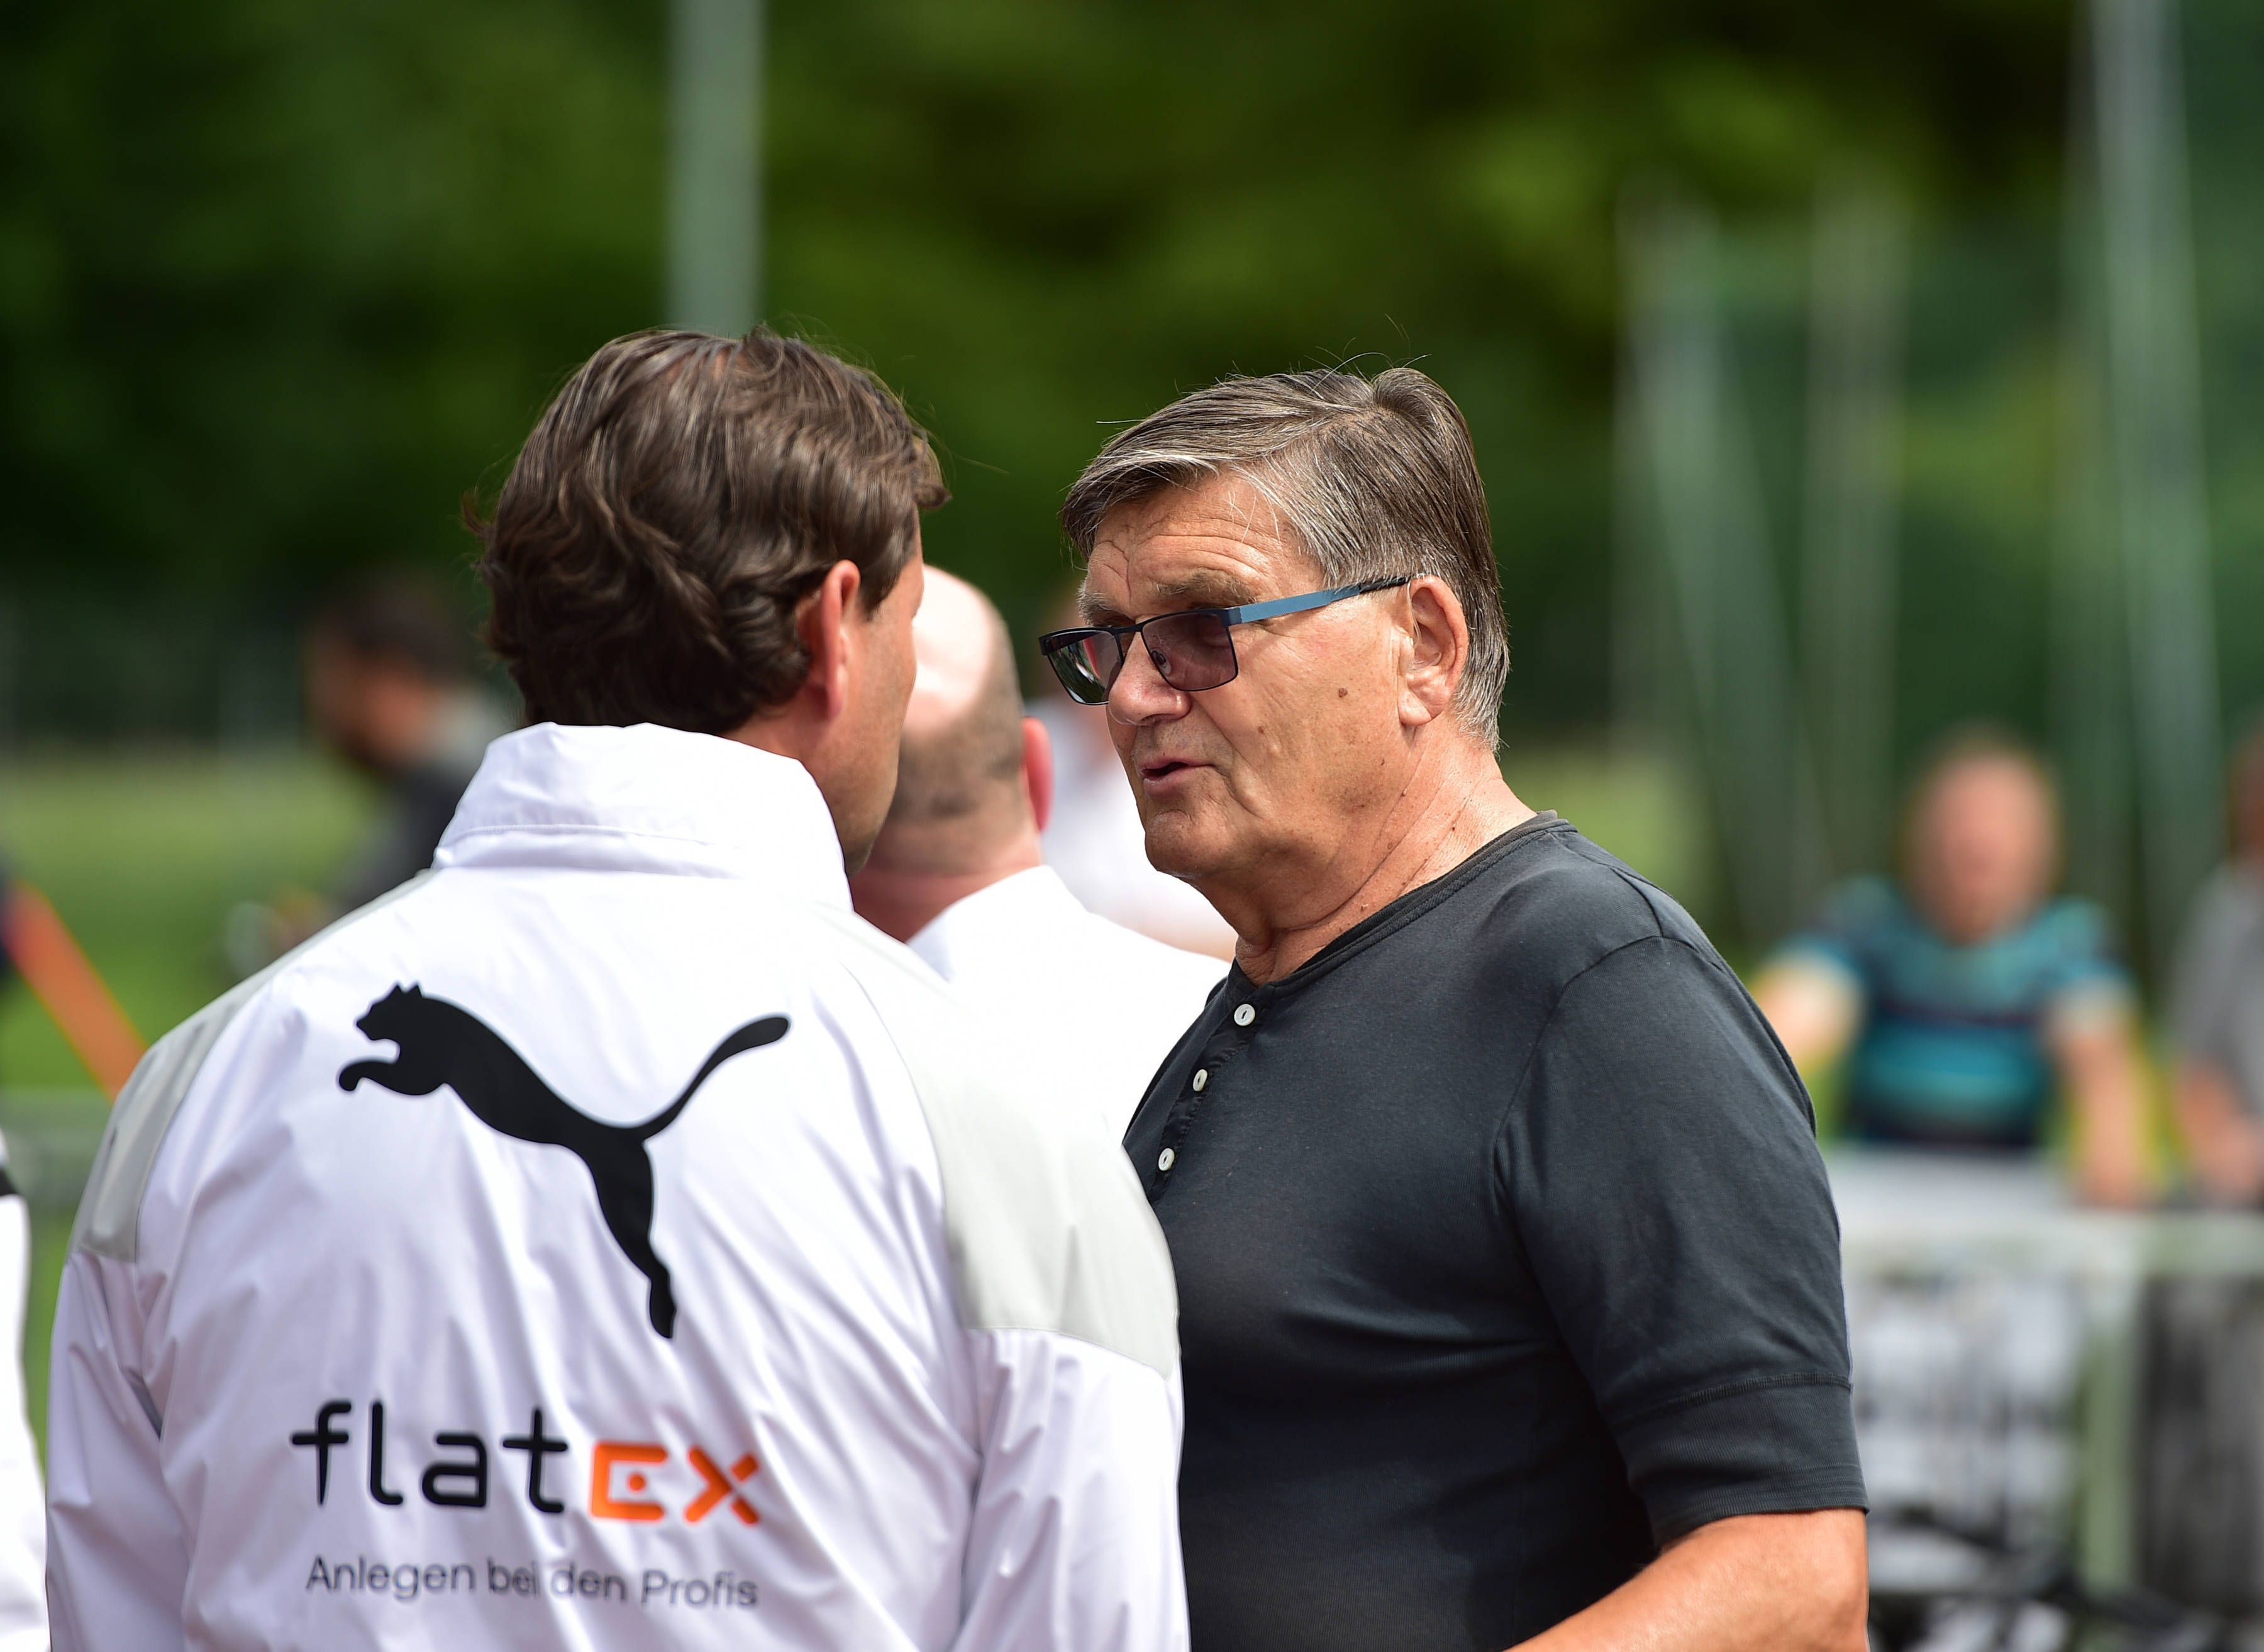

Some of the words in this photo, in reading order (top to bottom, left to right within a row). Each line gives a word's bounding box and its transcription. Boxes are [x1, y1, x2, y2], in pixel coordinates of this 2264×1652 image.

[306, 1555, 475, 1601] Anlegen
[487, 1556, 541, 1598] bei
[550, 1561, 628, 1600] den
[641, 1569, 759, 1607] Profis
